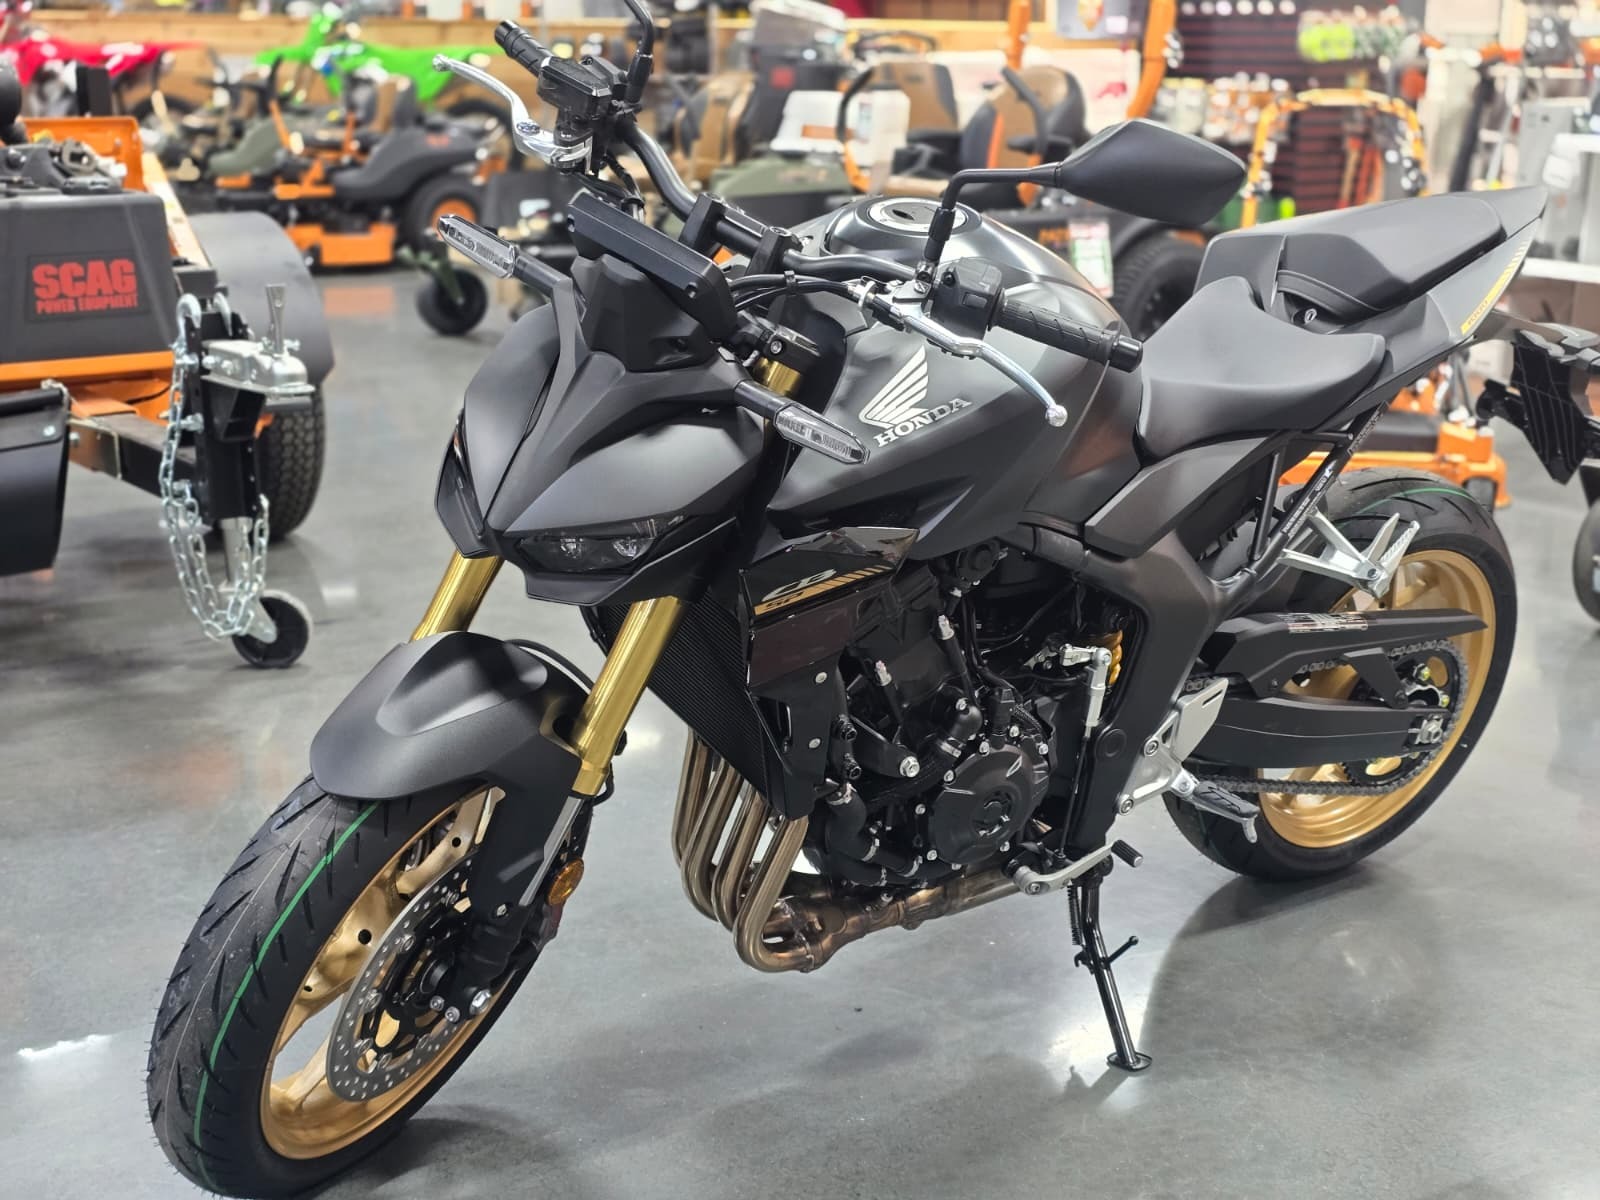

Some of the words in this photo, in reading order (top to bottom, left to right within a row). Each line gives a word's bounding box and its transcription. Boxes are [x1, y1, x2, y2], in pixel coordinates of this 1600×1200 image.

[32, 258, 137, 299] SCAG
[873, 398, 972, 447] HONDA
[761, 568, 837, 602] CB
